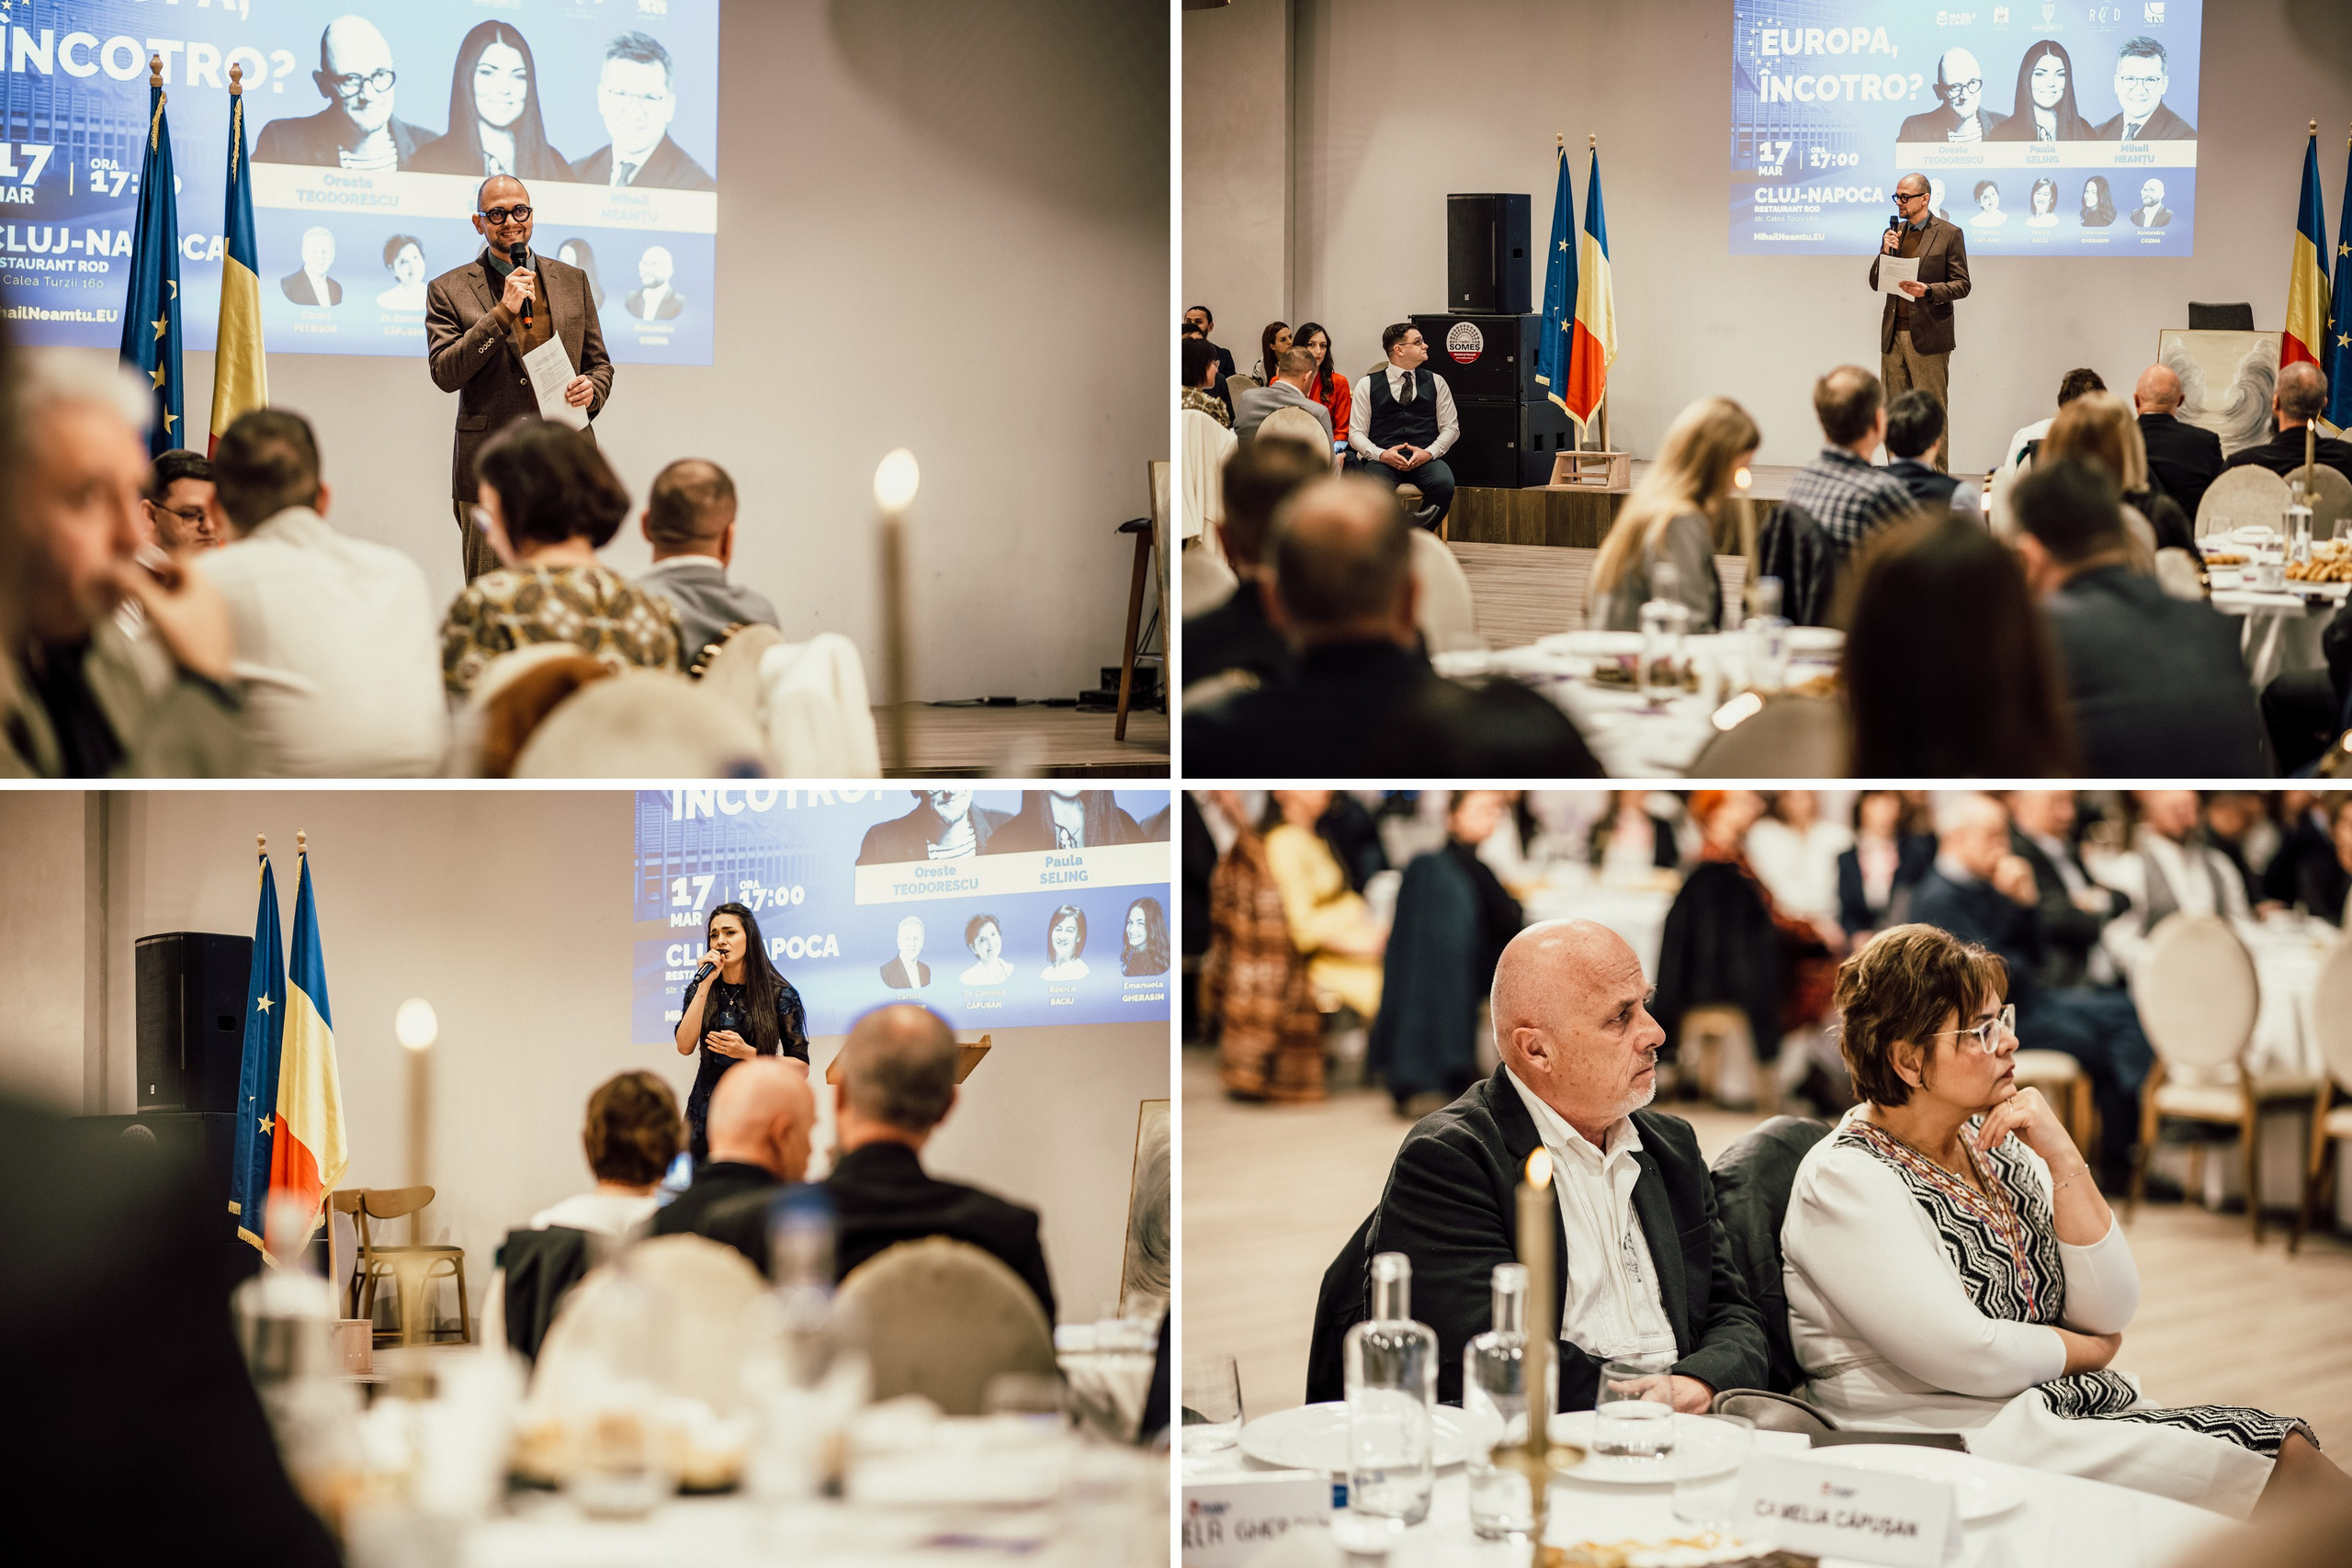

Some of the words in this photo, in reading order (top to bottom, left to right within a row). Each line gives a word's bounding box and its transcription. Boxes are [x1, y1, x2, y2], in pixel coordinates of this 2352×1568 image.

[1761, 26, 1899, 60] EUROPA,
[1758, 68, 1924, 103] ÎNCOTRO?
[1759, 141, 1792, 165] 17
[1810, 146, 1826, 154] ORA
[1939, 146, 1968, 155] Oreste
[2030, 145, 2056, 154] Paula
[2120, 143, 2150, 153] Mihail
[90, 157, 119, 171] ORA
[1810, 152, 1860, 169] 17:00
[1922, 156, 1984, 165] TEODORESCU
[2025, 155, 2060, 164] SELING
[1758, 165, 1783, 176] MAR
[296, 188, 399, 207] TEODORESCU
[1754, 186, 1885, 205] CLUJ-NAPOCA
[1754, 205, 1804, 213] RESTAURANT
[1804, 205, 1821, 213] ROD
[1753, 232, 1826, 242] MihailNeamtu.EU
[78, 260, 109, 274] ROD
[4, 275, 40, 287] Calea
[44, 276, 78, 288] Turzii
[82, 279, 104, 289] 160
[1045, 854, 1083, 869] Paula
[914, 865, 956, 878] Oreste
[1039, 870, 1089, 886] SELING
[740, 879, 760, 889] ORA
[892, 878, 979, 897] TEODORESCU
[671, 874, 716, 910] 17
[739, 885, 805, 911] 17:00
[670, 911, 702, 927] MAR
[1123, 980, 1164, 990] Emanuela
[1049, 997, 1075, 1007] BACIU
[1122, 993, 1165, 1003] GHERASIM
